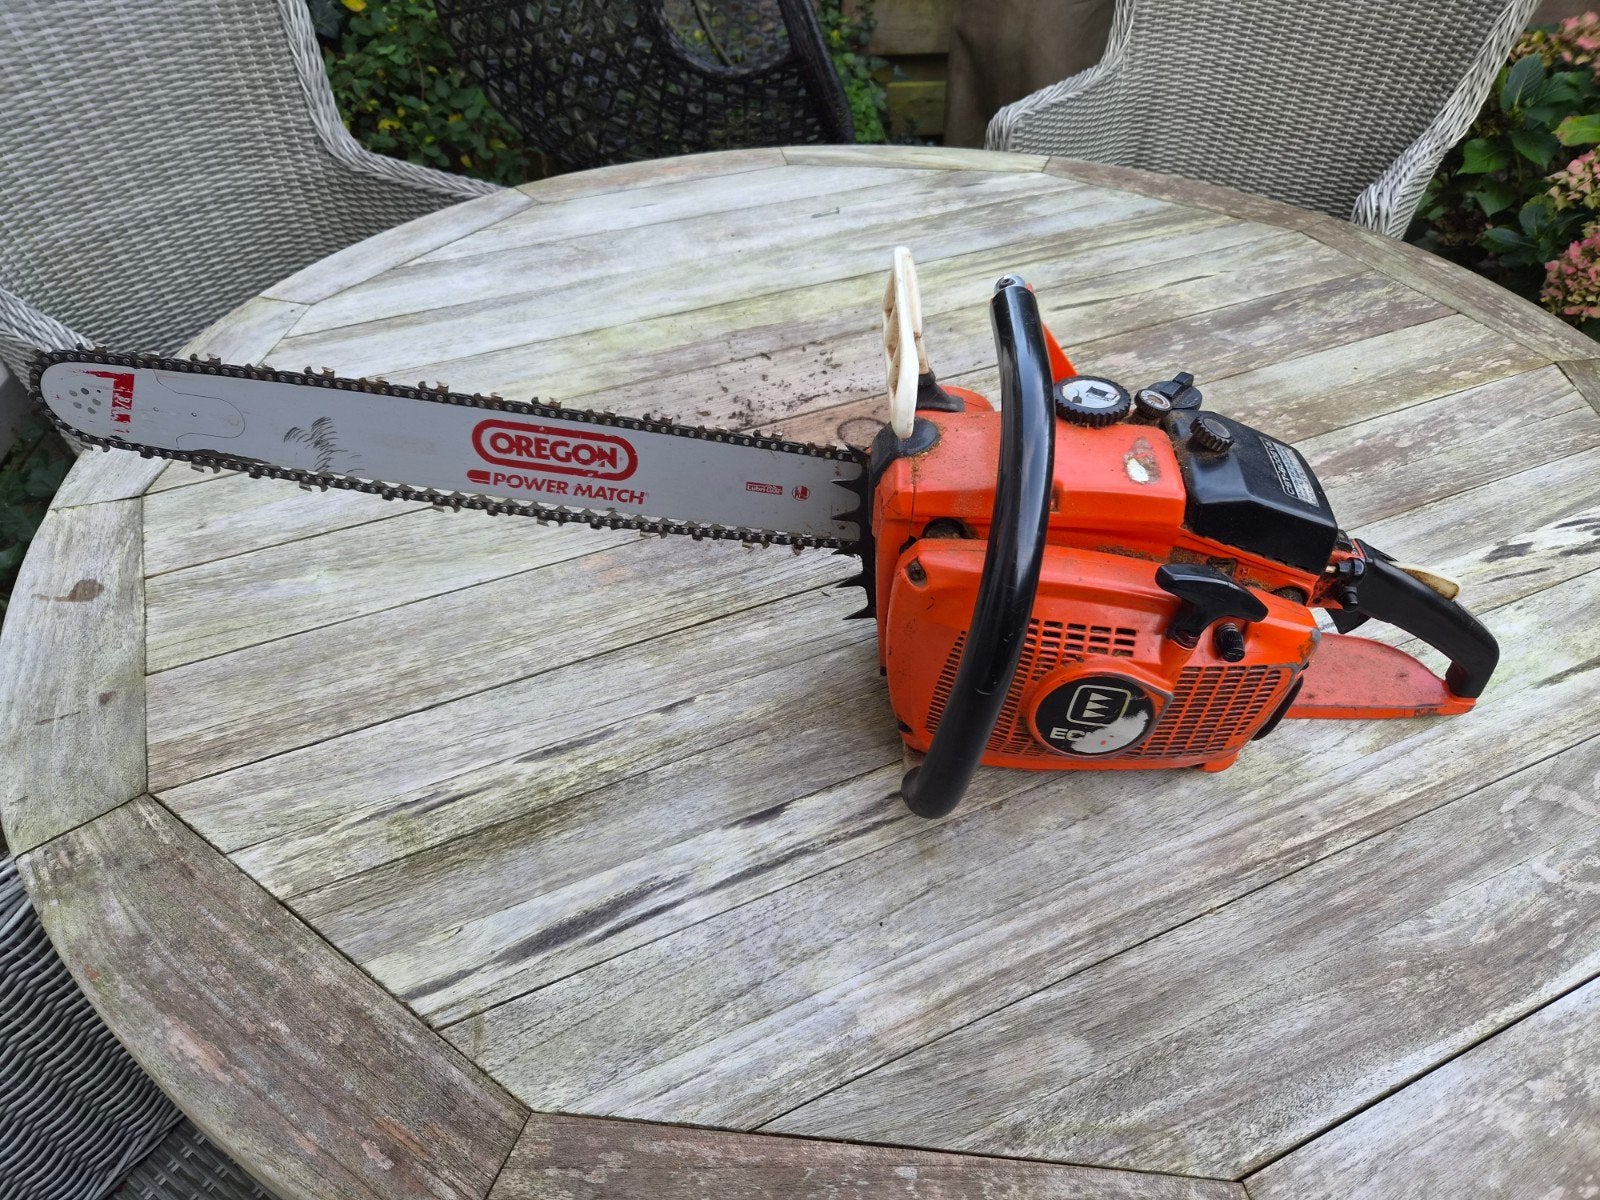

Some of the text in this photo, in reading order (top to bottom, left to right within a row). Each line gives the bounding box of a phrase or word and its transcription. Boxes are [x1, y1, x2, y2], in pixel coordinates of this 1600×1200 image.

[489, 432, 618, 470] OREGON
[493, 472, 645, 505] POWER MATCH
